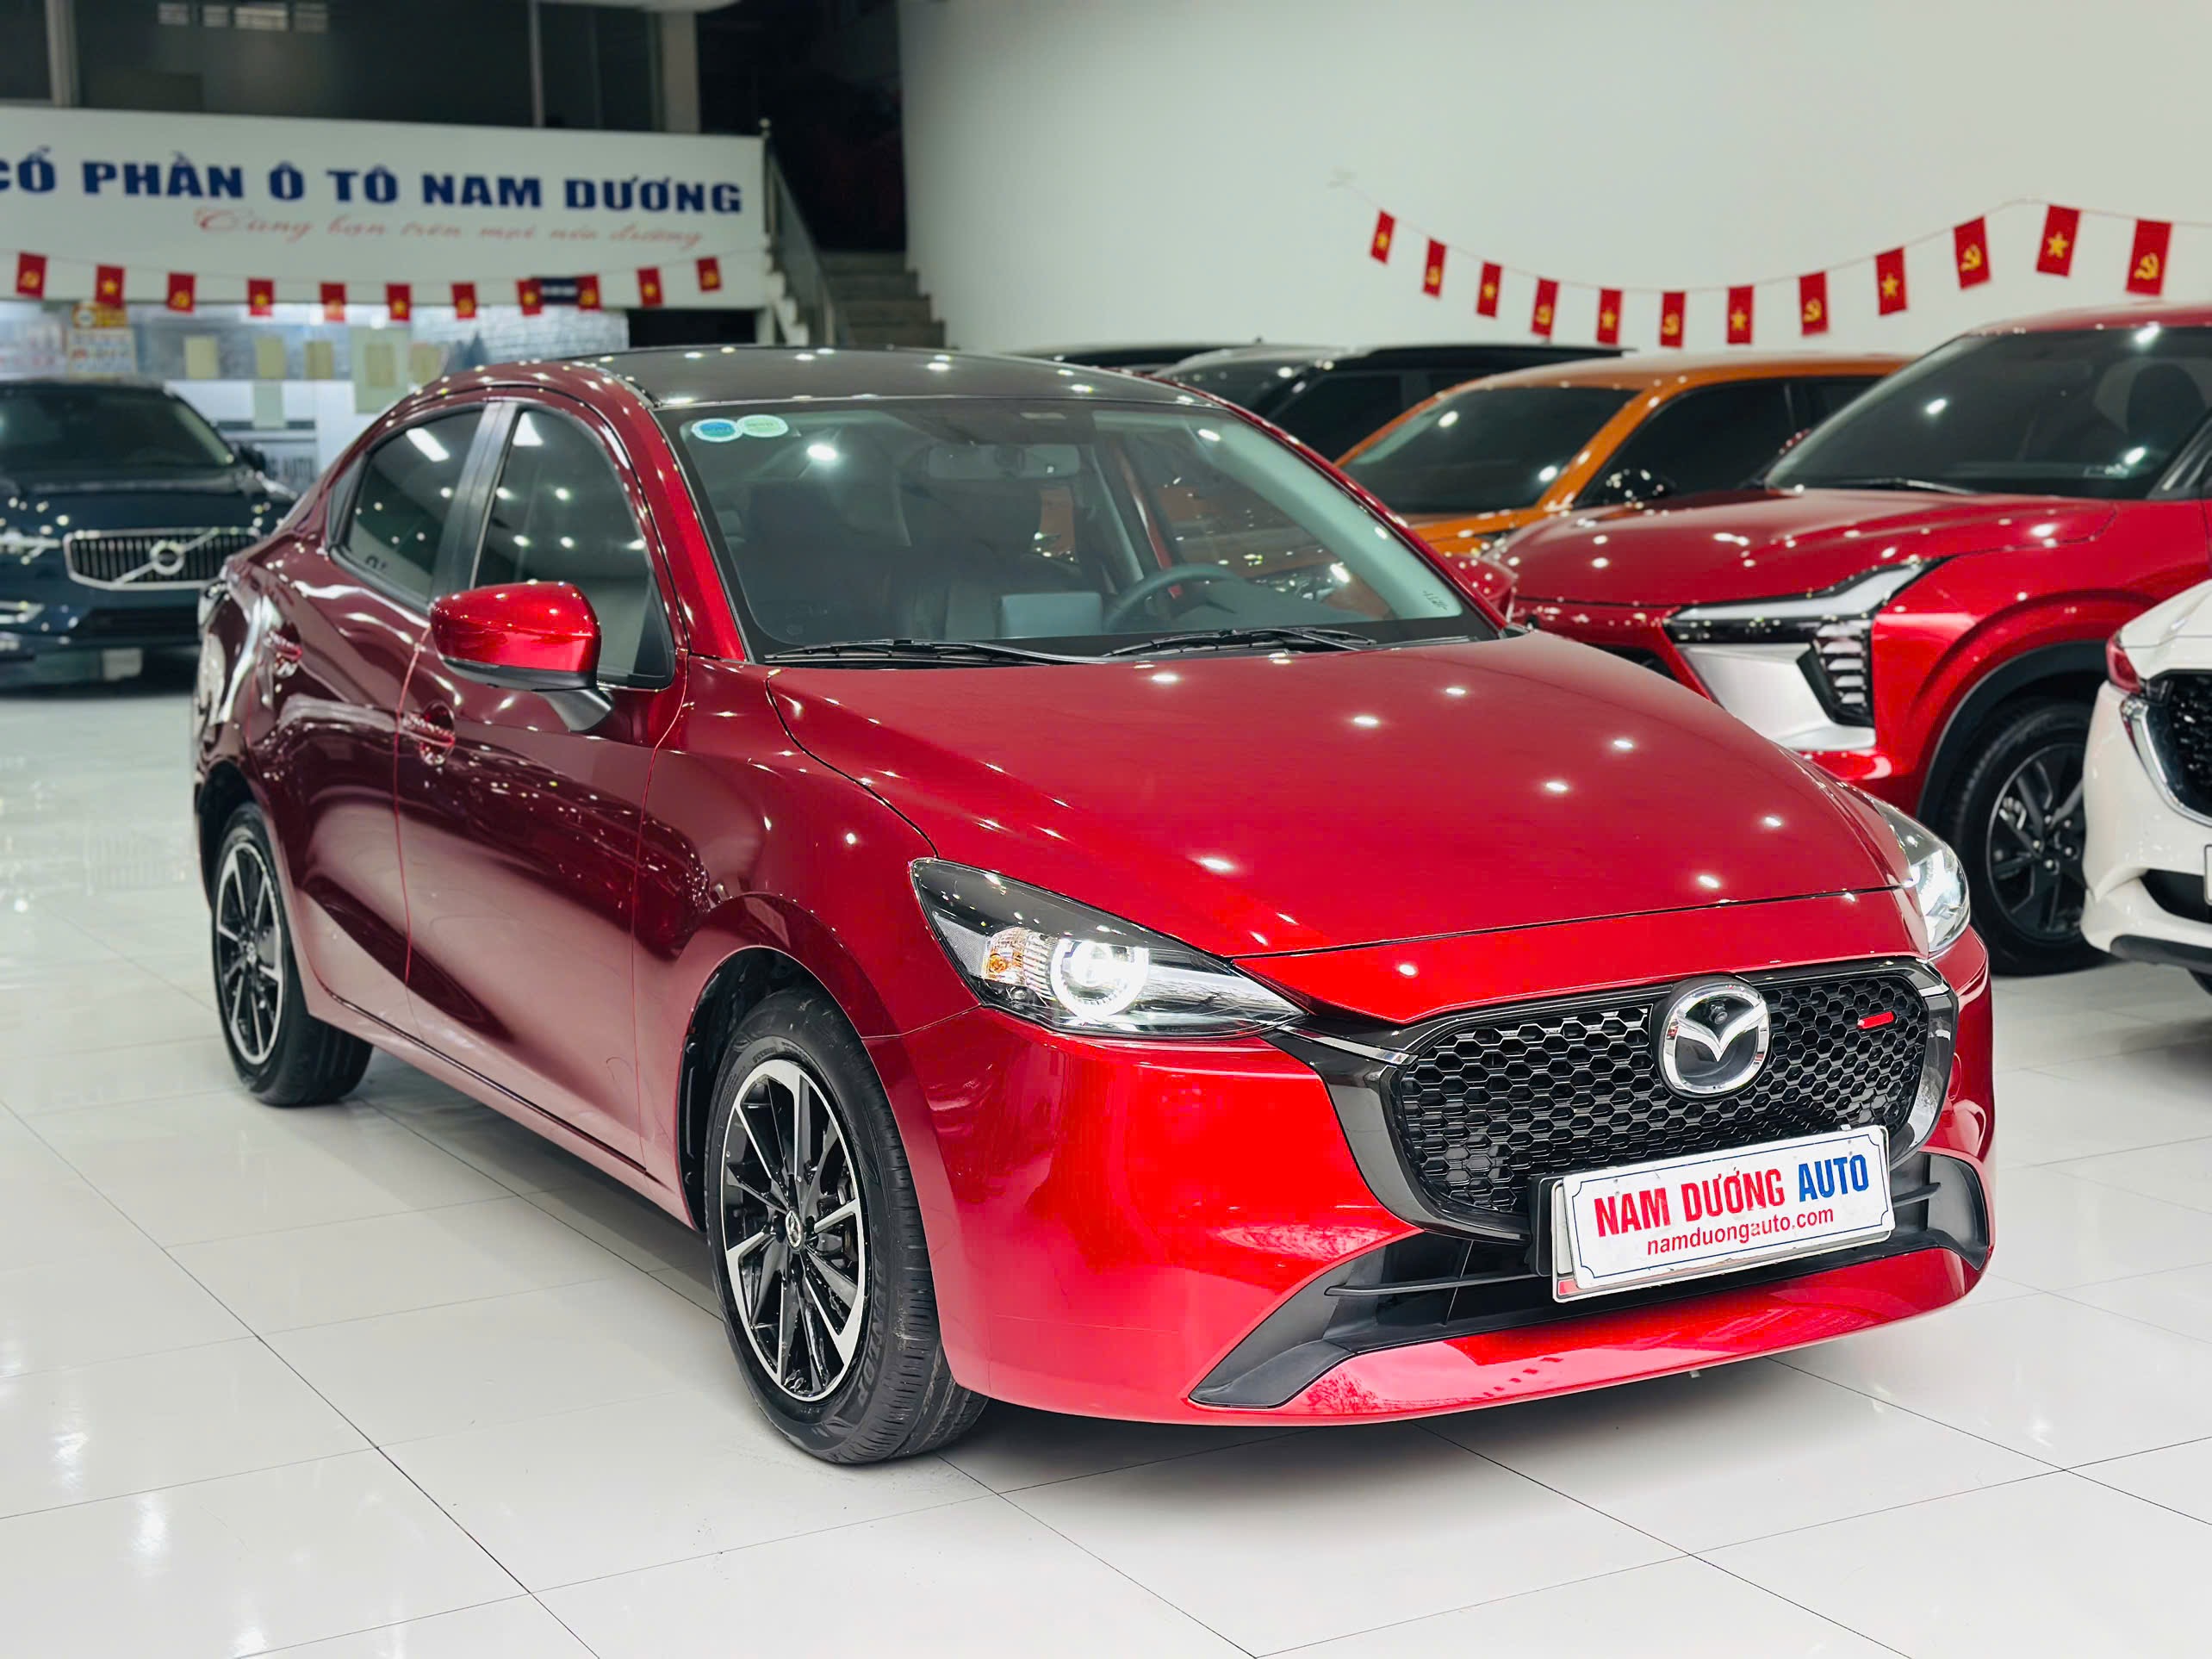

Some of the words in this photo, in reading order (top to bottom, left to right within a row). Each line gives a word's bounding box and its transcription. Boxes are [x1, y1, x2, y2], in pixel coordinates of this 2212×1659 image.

[0, 146, 55, 193] Ổ
[82, 150, 244, 198] PHẦN
[269, 161, 305, 201] Ô
[326, 165, 398, 204] TÔ
[421, 175, 542, 208] NAM
[565, 176, 741, 214] DƯƠNG
[1594, 1188, 1671, 1237] NAM
[1798, 1154, 1869, 1202] AUTO
[1647, 1209, 1834, 1255] namduongauto.com
